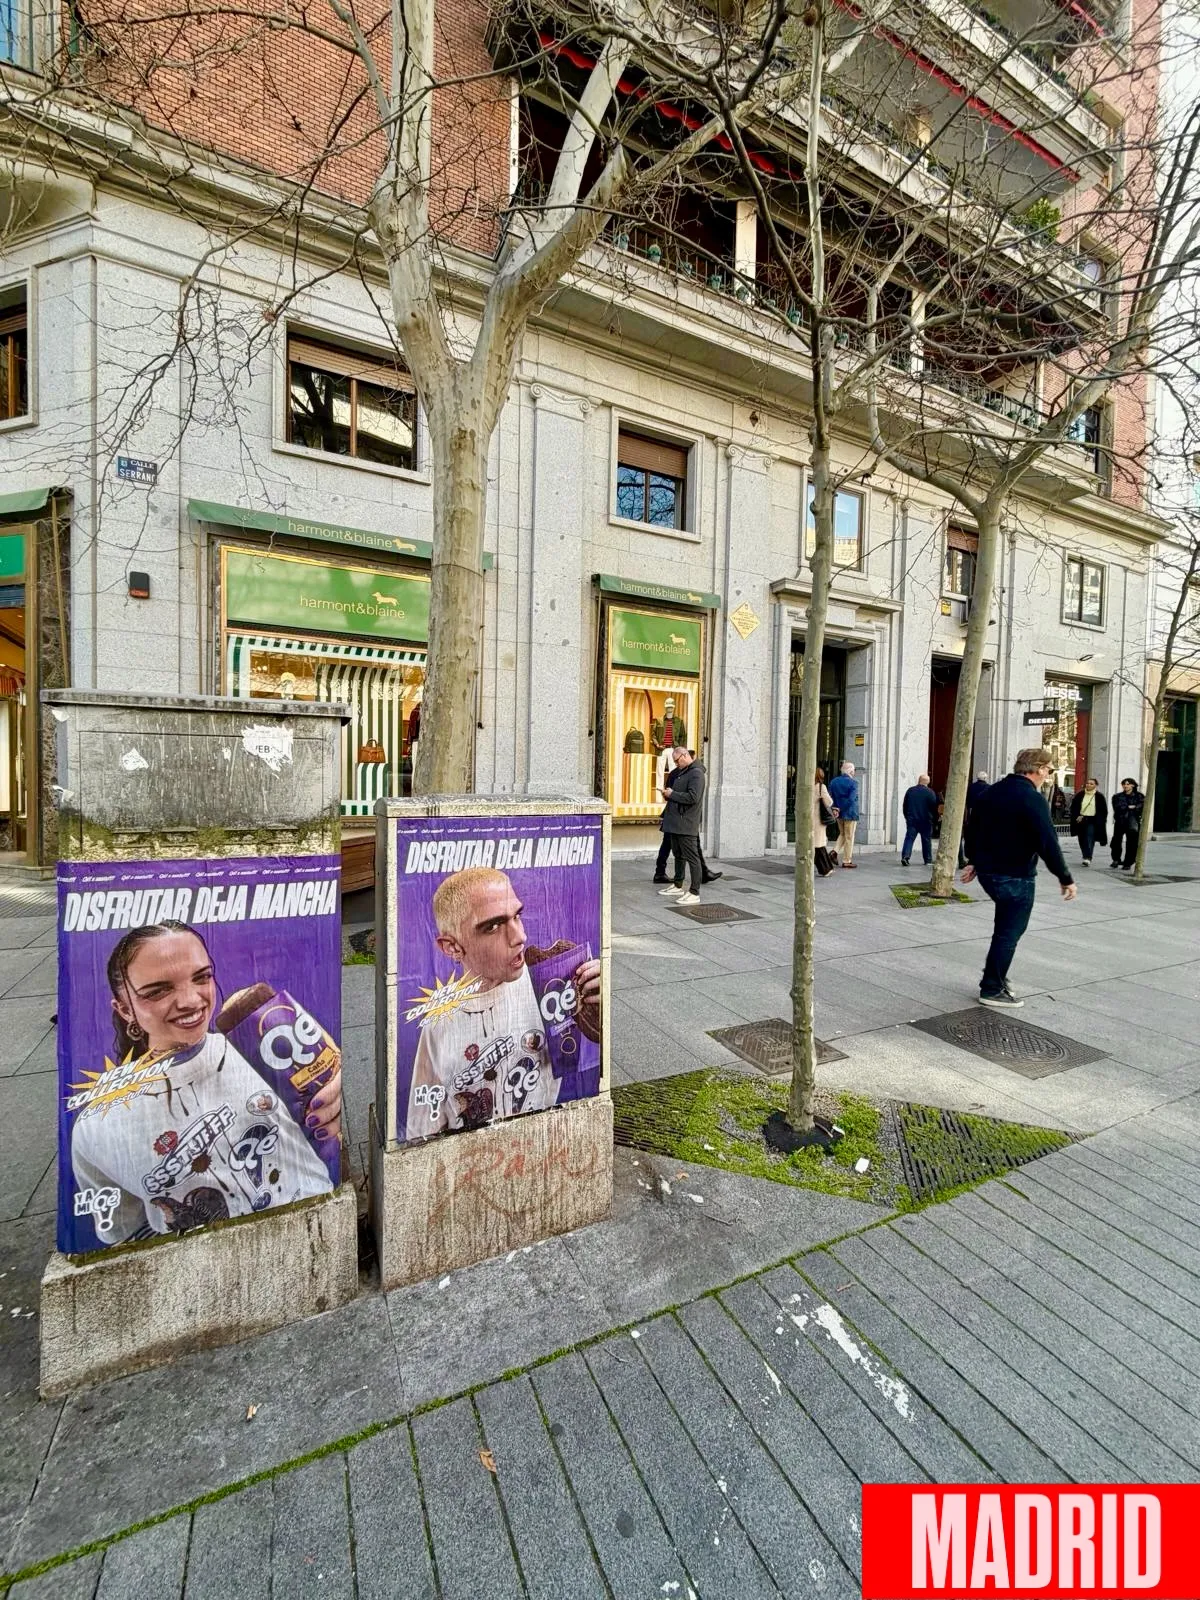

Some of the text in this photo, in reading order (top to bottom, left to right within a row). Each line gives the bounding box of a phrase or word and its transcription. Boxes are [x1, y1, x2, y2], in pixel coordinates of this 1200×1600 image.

[131, 460, 154, 469] CALLE
[288, 520, 392, 548] harmont&blaine
[620, 582, 687, 600] harmont&blaine
[300, 595, 405, 619] harmont&blaine
[622, 638, 691, 656] harmont&blaine
[405, 836, 595, 874] DISFRUTAR DEJA MANCHA
[63, 880, 338, 932] DISFRUTAR DEJA MANCHA
[406, 980, 483, 1021] COLLECTION
[430, 980, 461, 1001] NEW
[67, 1057, 175, 1108] COLLECTION
[96, 1059, 141, 1086] NEW
